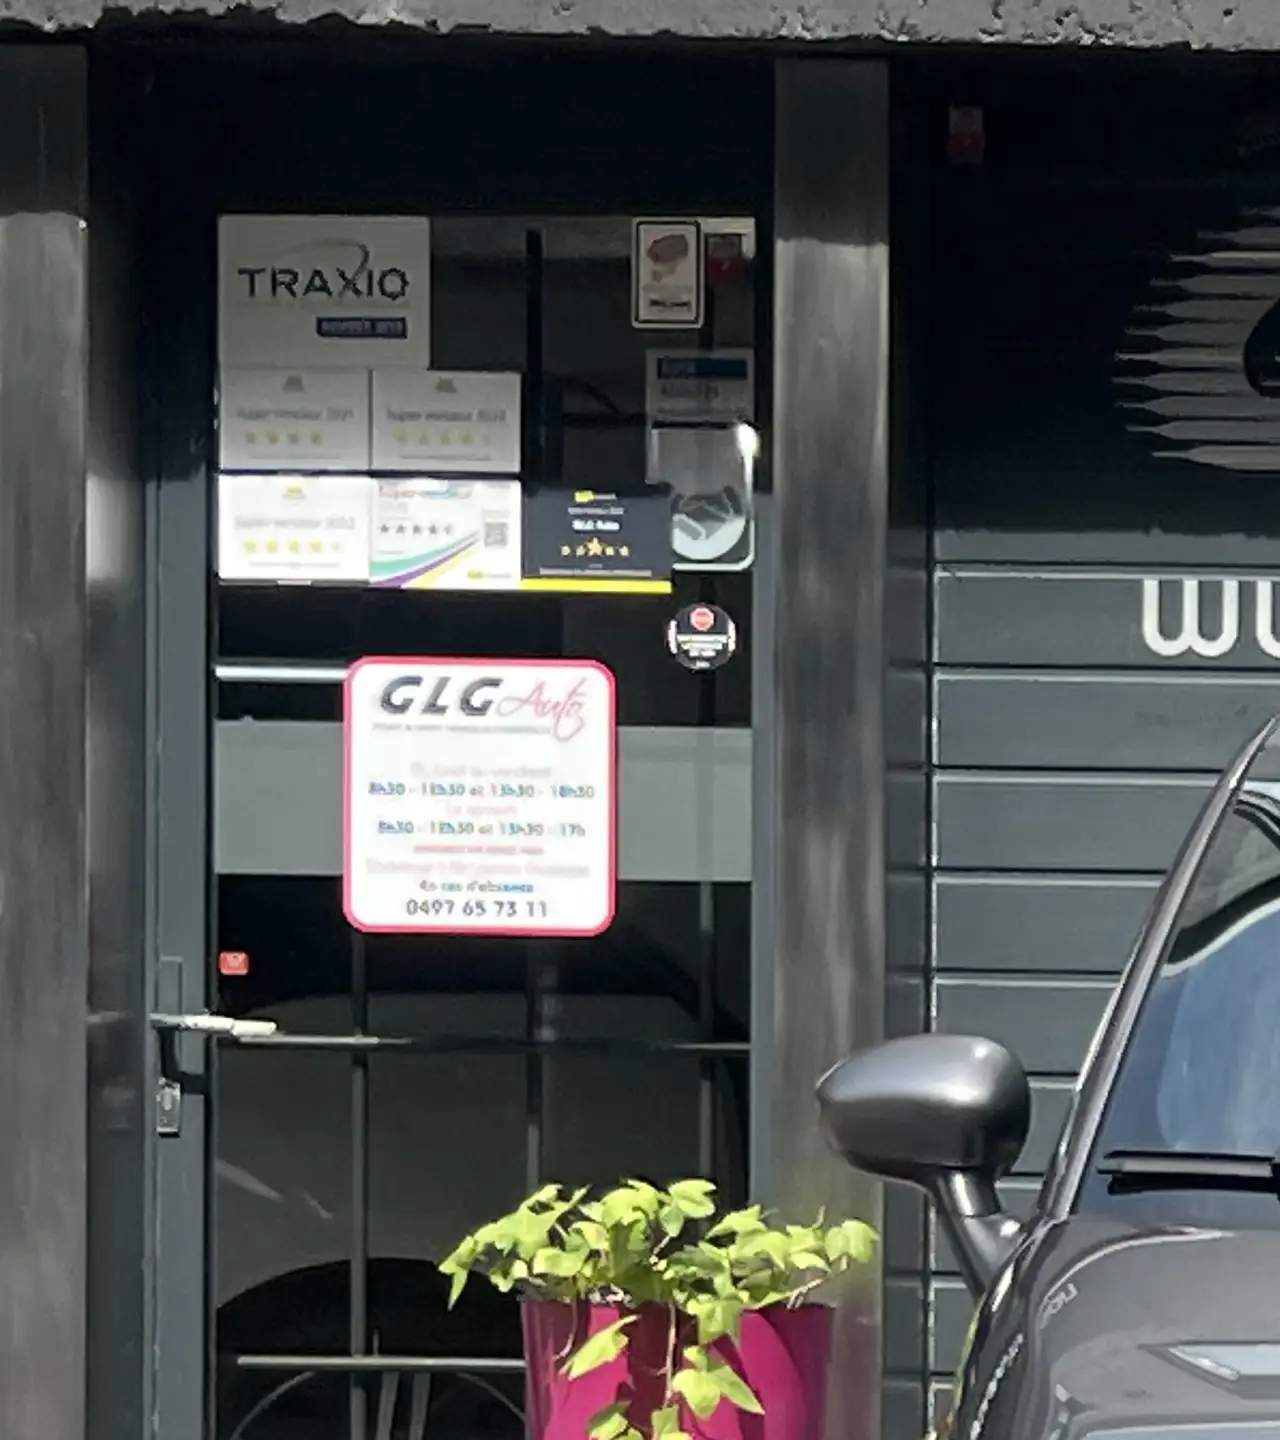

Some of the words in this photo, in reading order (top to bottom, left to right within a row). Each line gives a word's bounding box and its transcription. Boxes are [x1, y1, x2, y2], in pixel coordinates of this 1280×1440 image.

[237, 265, 410, 301] TRAXIO
[379, 676, 505, 716] GLG
[497, 677, 588, 741] Auto
[406, 898, 455, 916] 0497
[462, 899, 487, 917] 65
[493, 900, 518, 918] 73
[526, 900, 548, 918] 11
